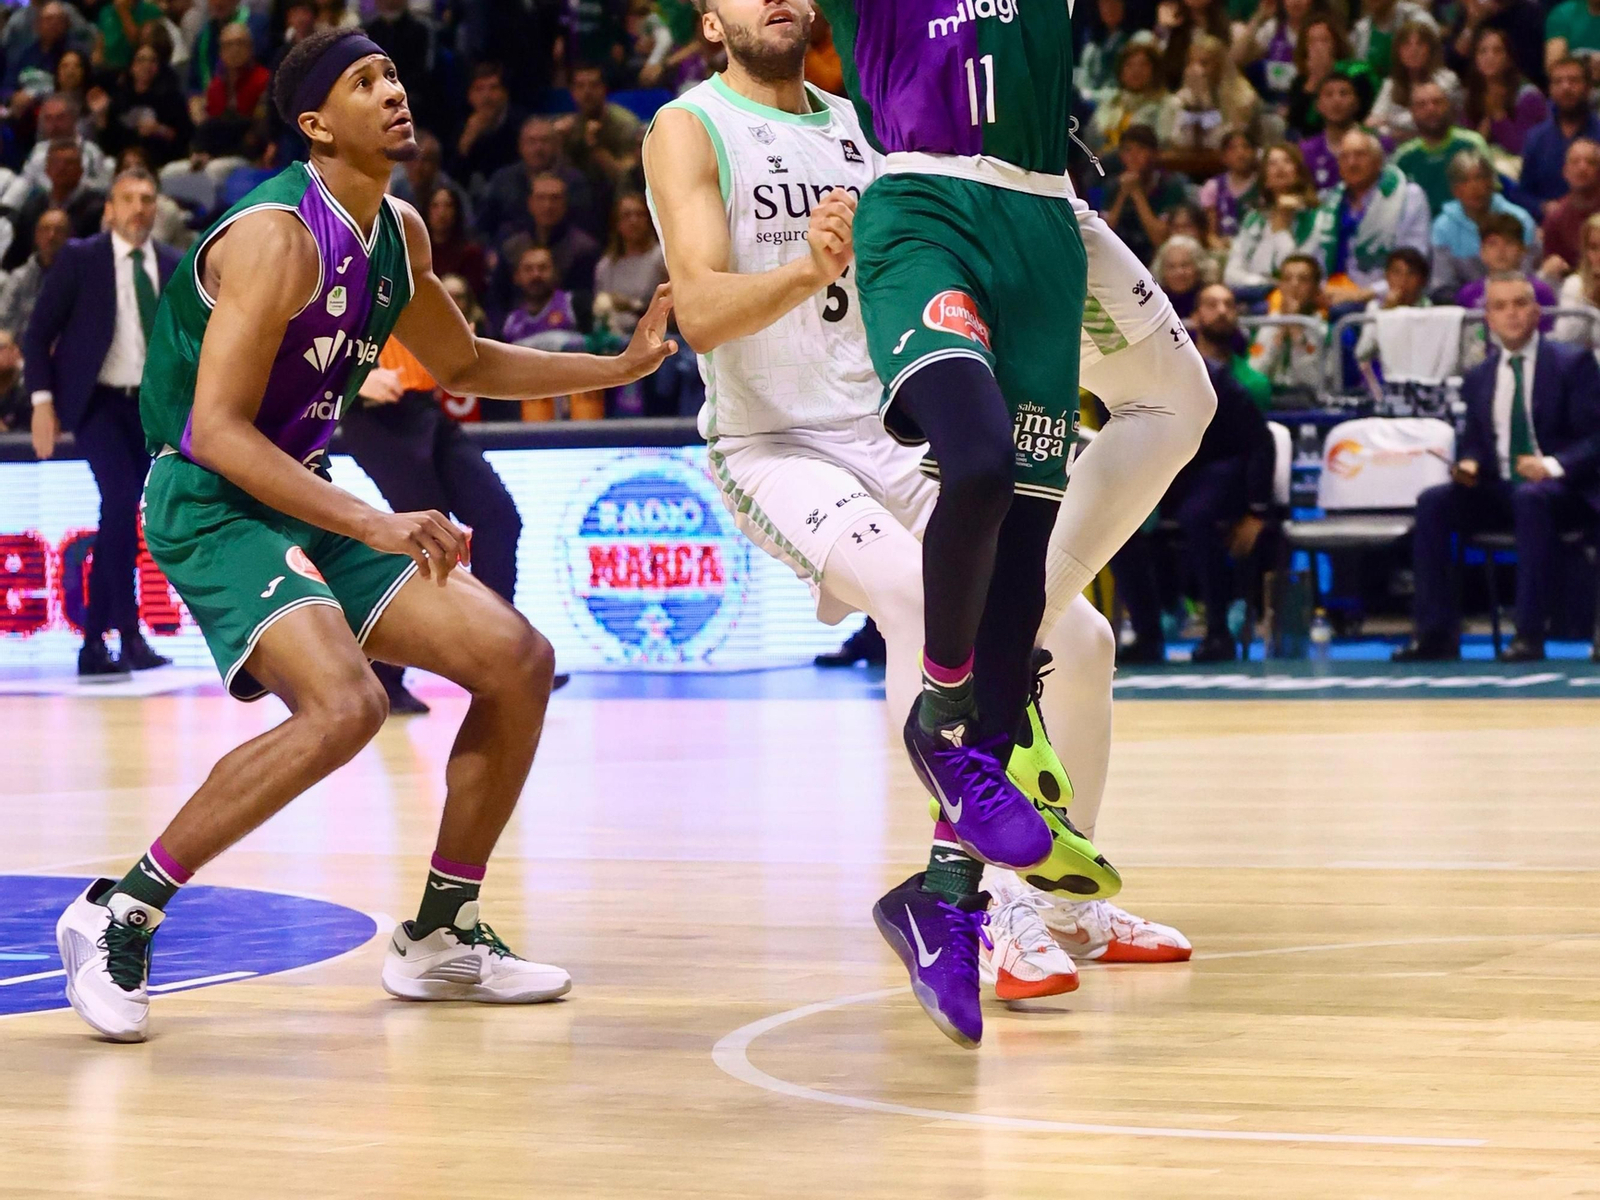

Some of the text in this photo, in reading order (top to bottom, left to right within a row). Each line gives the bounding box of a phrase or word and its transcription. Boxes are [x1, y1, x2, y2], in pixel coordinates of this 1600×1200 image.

[965, 54, 996, 126] 11
[1015, 411, 1023, 422] a
[1017, 401, 1046, 414] sabor
[588, 544, 723, 588] MARCA
